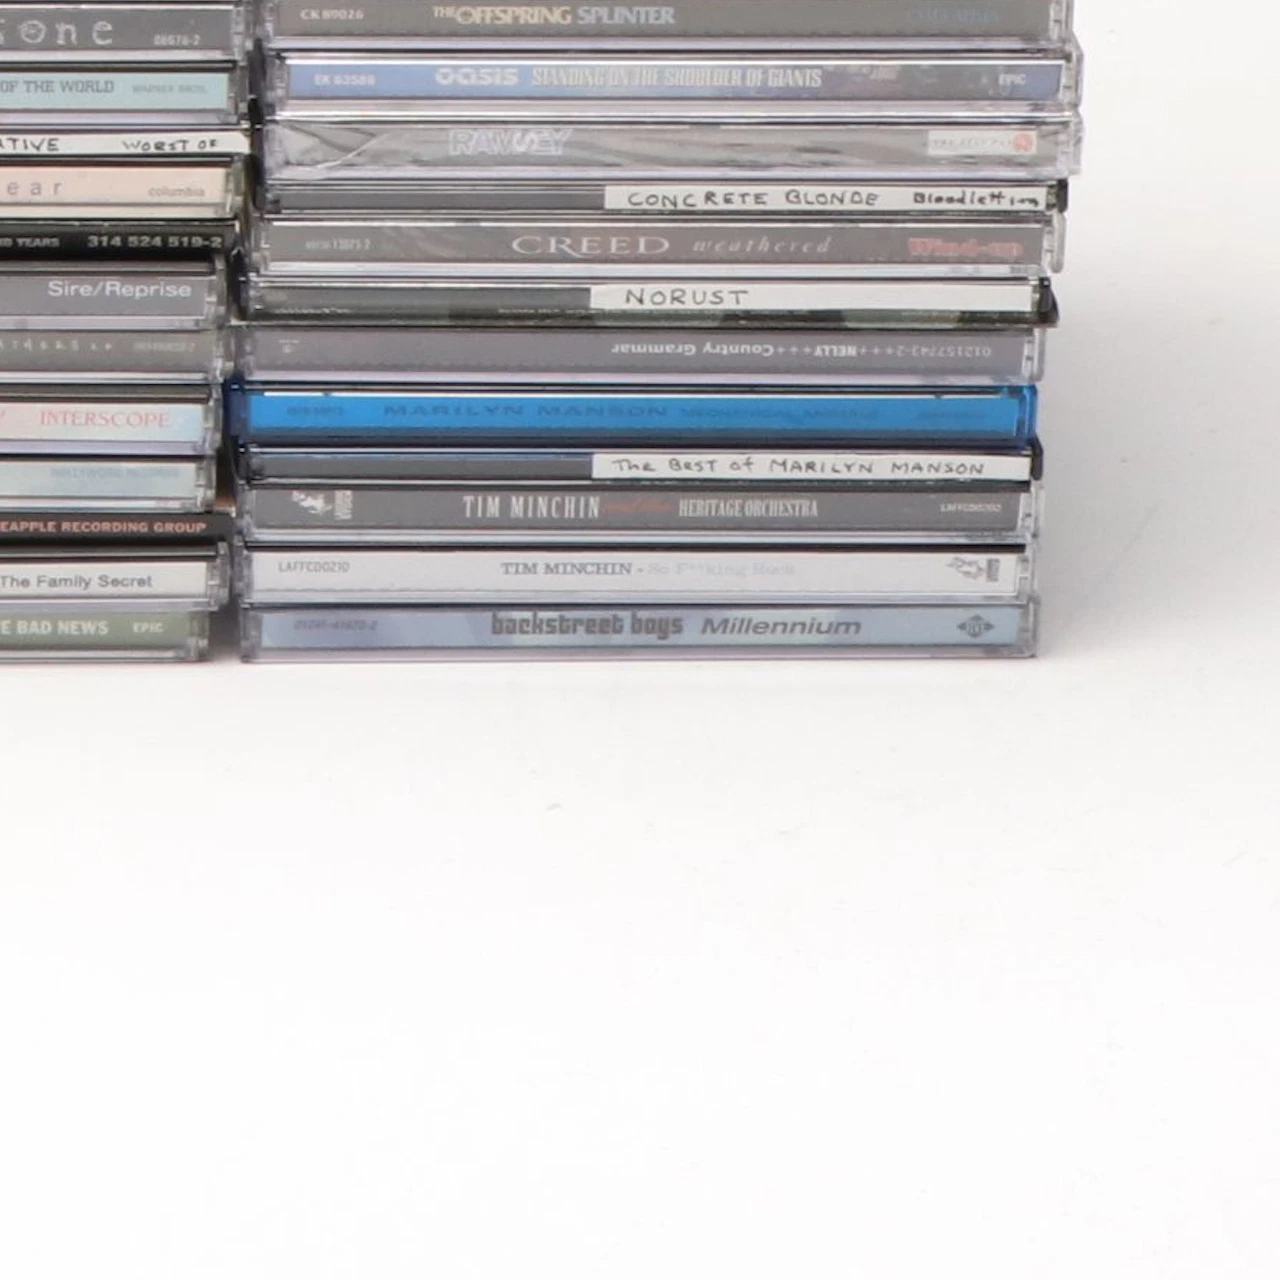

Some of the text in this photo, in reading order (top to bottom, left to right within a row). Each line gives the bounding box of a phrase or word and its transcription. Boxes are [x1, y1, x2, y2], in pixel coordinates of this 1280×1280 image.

[464, 496, 599, 517] TIM MINCHIN
[492, 614, 861, 636] backstreet boys Millennium
